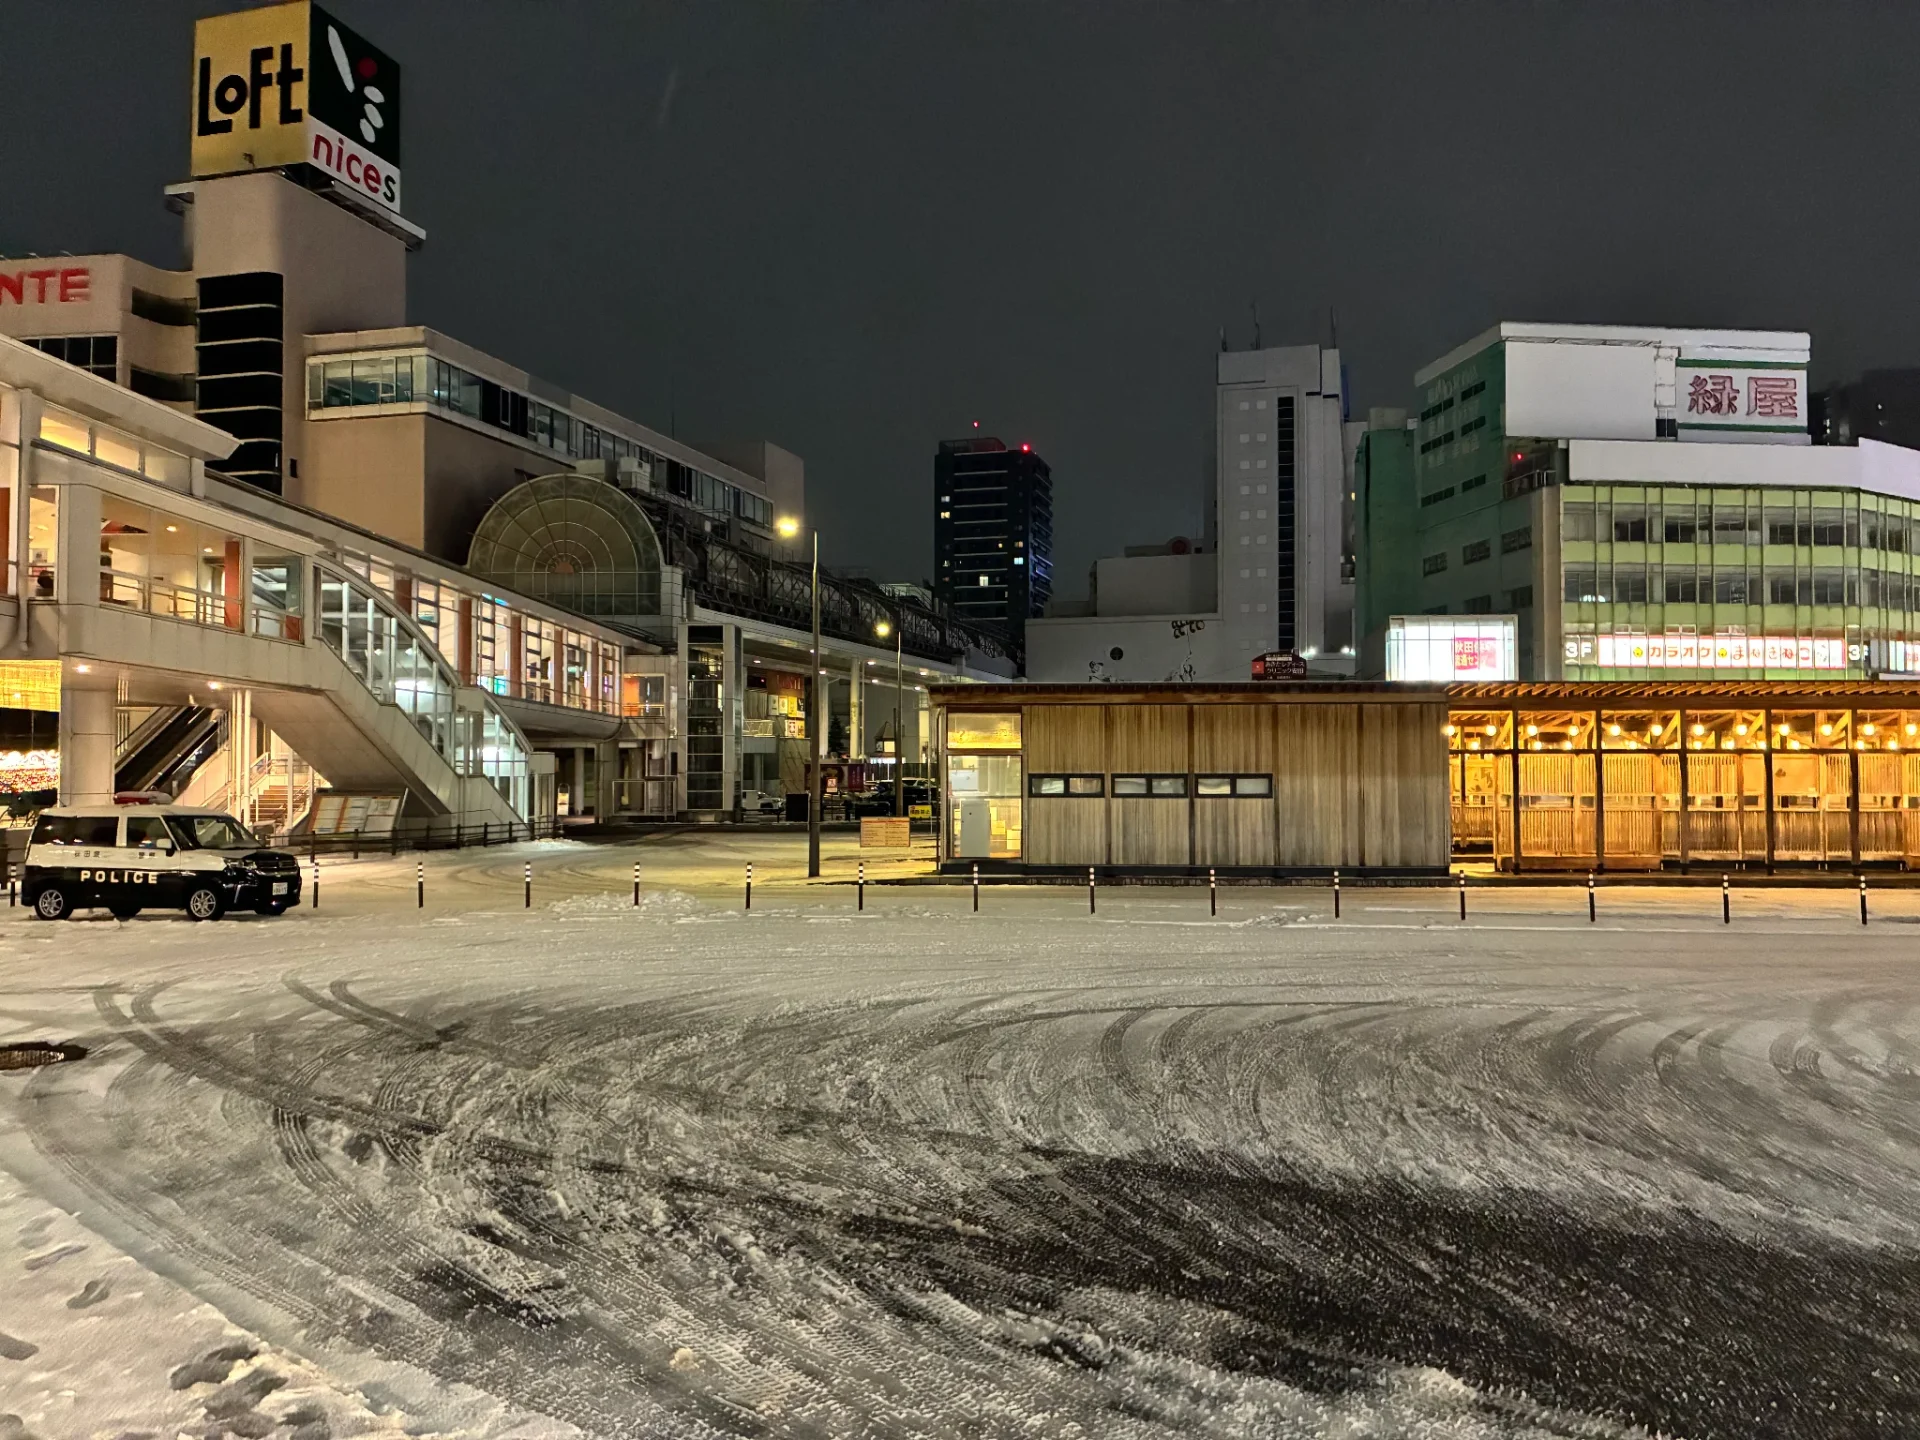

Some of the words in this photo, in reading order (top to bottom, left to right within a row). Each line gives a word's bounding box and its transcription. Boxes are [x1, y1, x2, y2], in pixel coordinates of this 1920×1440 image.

[313, 133, 397, 204] nices
[0, 267, 90, 306] NTE
[1688, 375, 1798, 418] 緑屋
[1565, 641, 1592, 658] 3F
[1650, 646, 1711, 658] カラオケ
[1732, 645, 1811, 661] まねきねこ
[80, 869, 158, 884] POLICE
